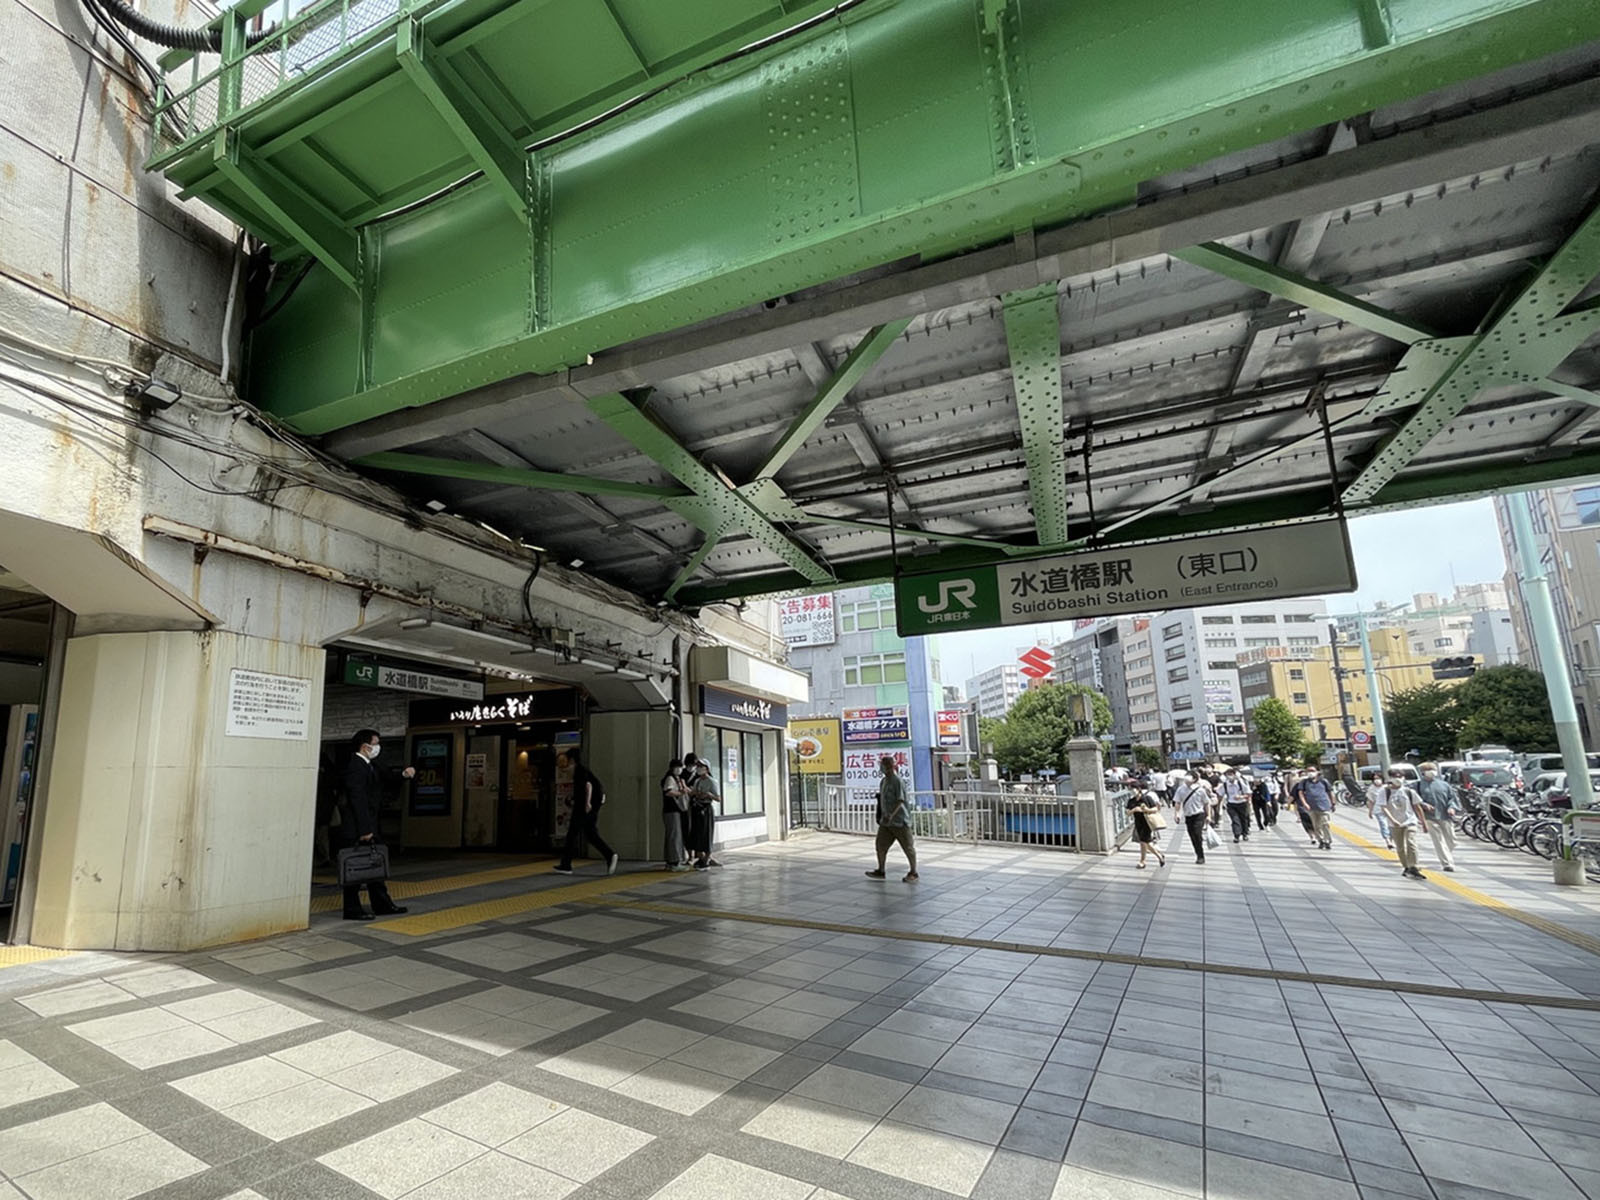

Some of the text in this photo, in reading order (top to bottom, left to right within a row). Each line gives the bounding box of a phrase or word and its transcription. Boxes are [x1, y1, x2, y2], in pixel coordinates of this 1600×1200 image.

[1010, 559, 1134, 597] 水道橋駅
[918, 578, 977, 613] JR
[1011, 577, 1279, 615] Suidōbashi Station (East Entrance)
[927, 611, 971, 625] JR東日本
[356, 666, 373, 679] JR
[384, 671, 429, 691] 水道橋駅
[846, 752, 909, 769] 広告集
